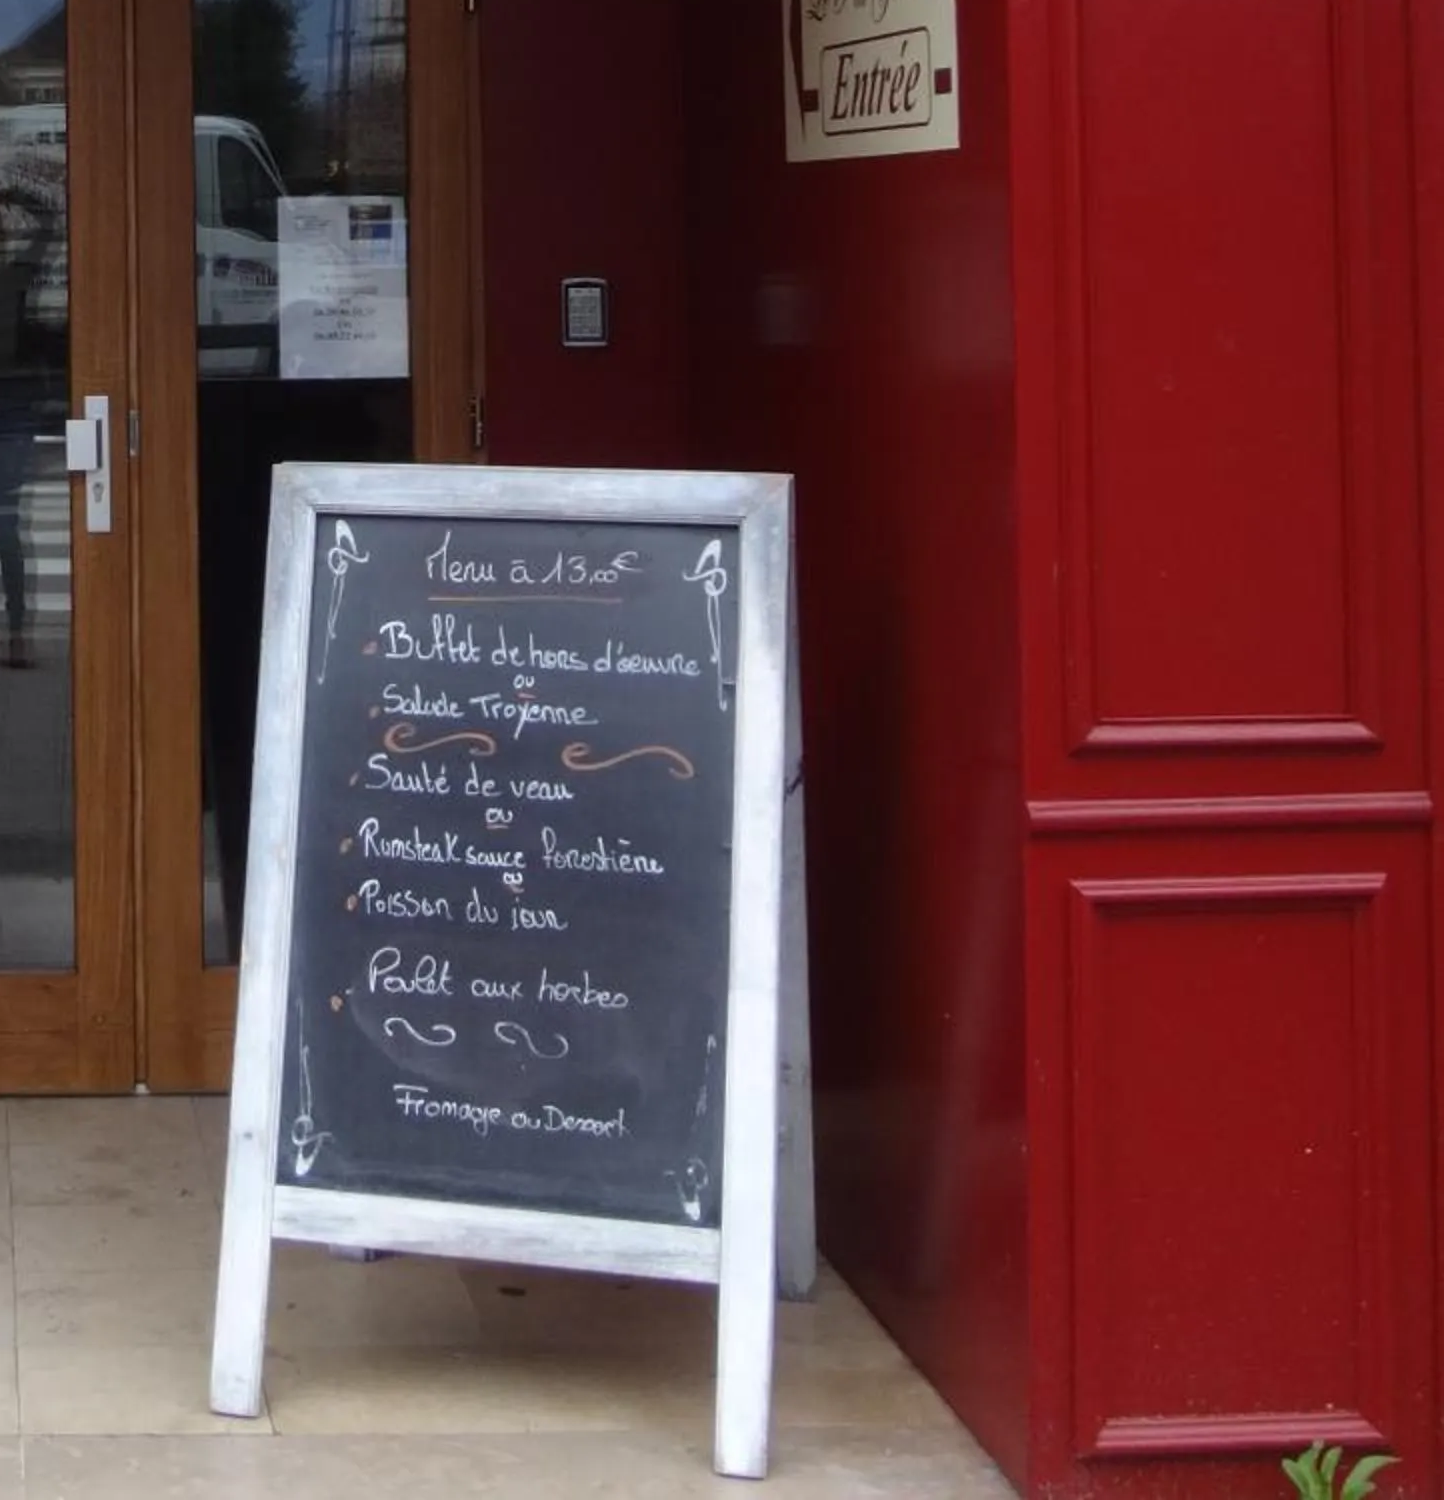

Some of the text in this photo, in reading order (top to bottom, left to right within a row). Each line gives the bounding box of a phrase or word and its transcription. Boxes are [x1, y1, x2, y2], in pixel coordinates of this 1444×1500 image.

[830, 40, 921, 121] Entrée
[425, 529, 496, 584] Menu
[509, 560, 536, 583] à
[379, 613, 480, 663] Buffet
[491, 625, 526, 666] de
[529, 632, 588, 672] hors
[382, 683, 599, 740] Salade Troyenne
[365, 753, 575, 801] Sauté de veau
[465, 846, 527, 869] sauce
[359, 879, 453, 921] Poisson
[466, 886, 499, 925] du
[369, 946, 457, 997] Poulet
[471, 977, 524, 999] aux
[392, 1083, 501, 1138] Fromage
[510, 1111, 541, 1130] ou
